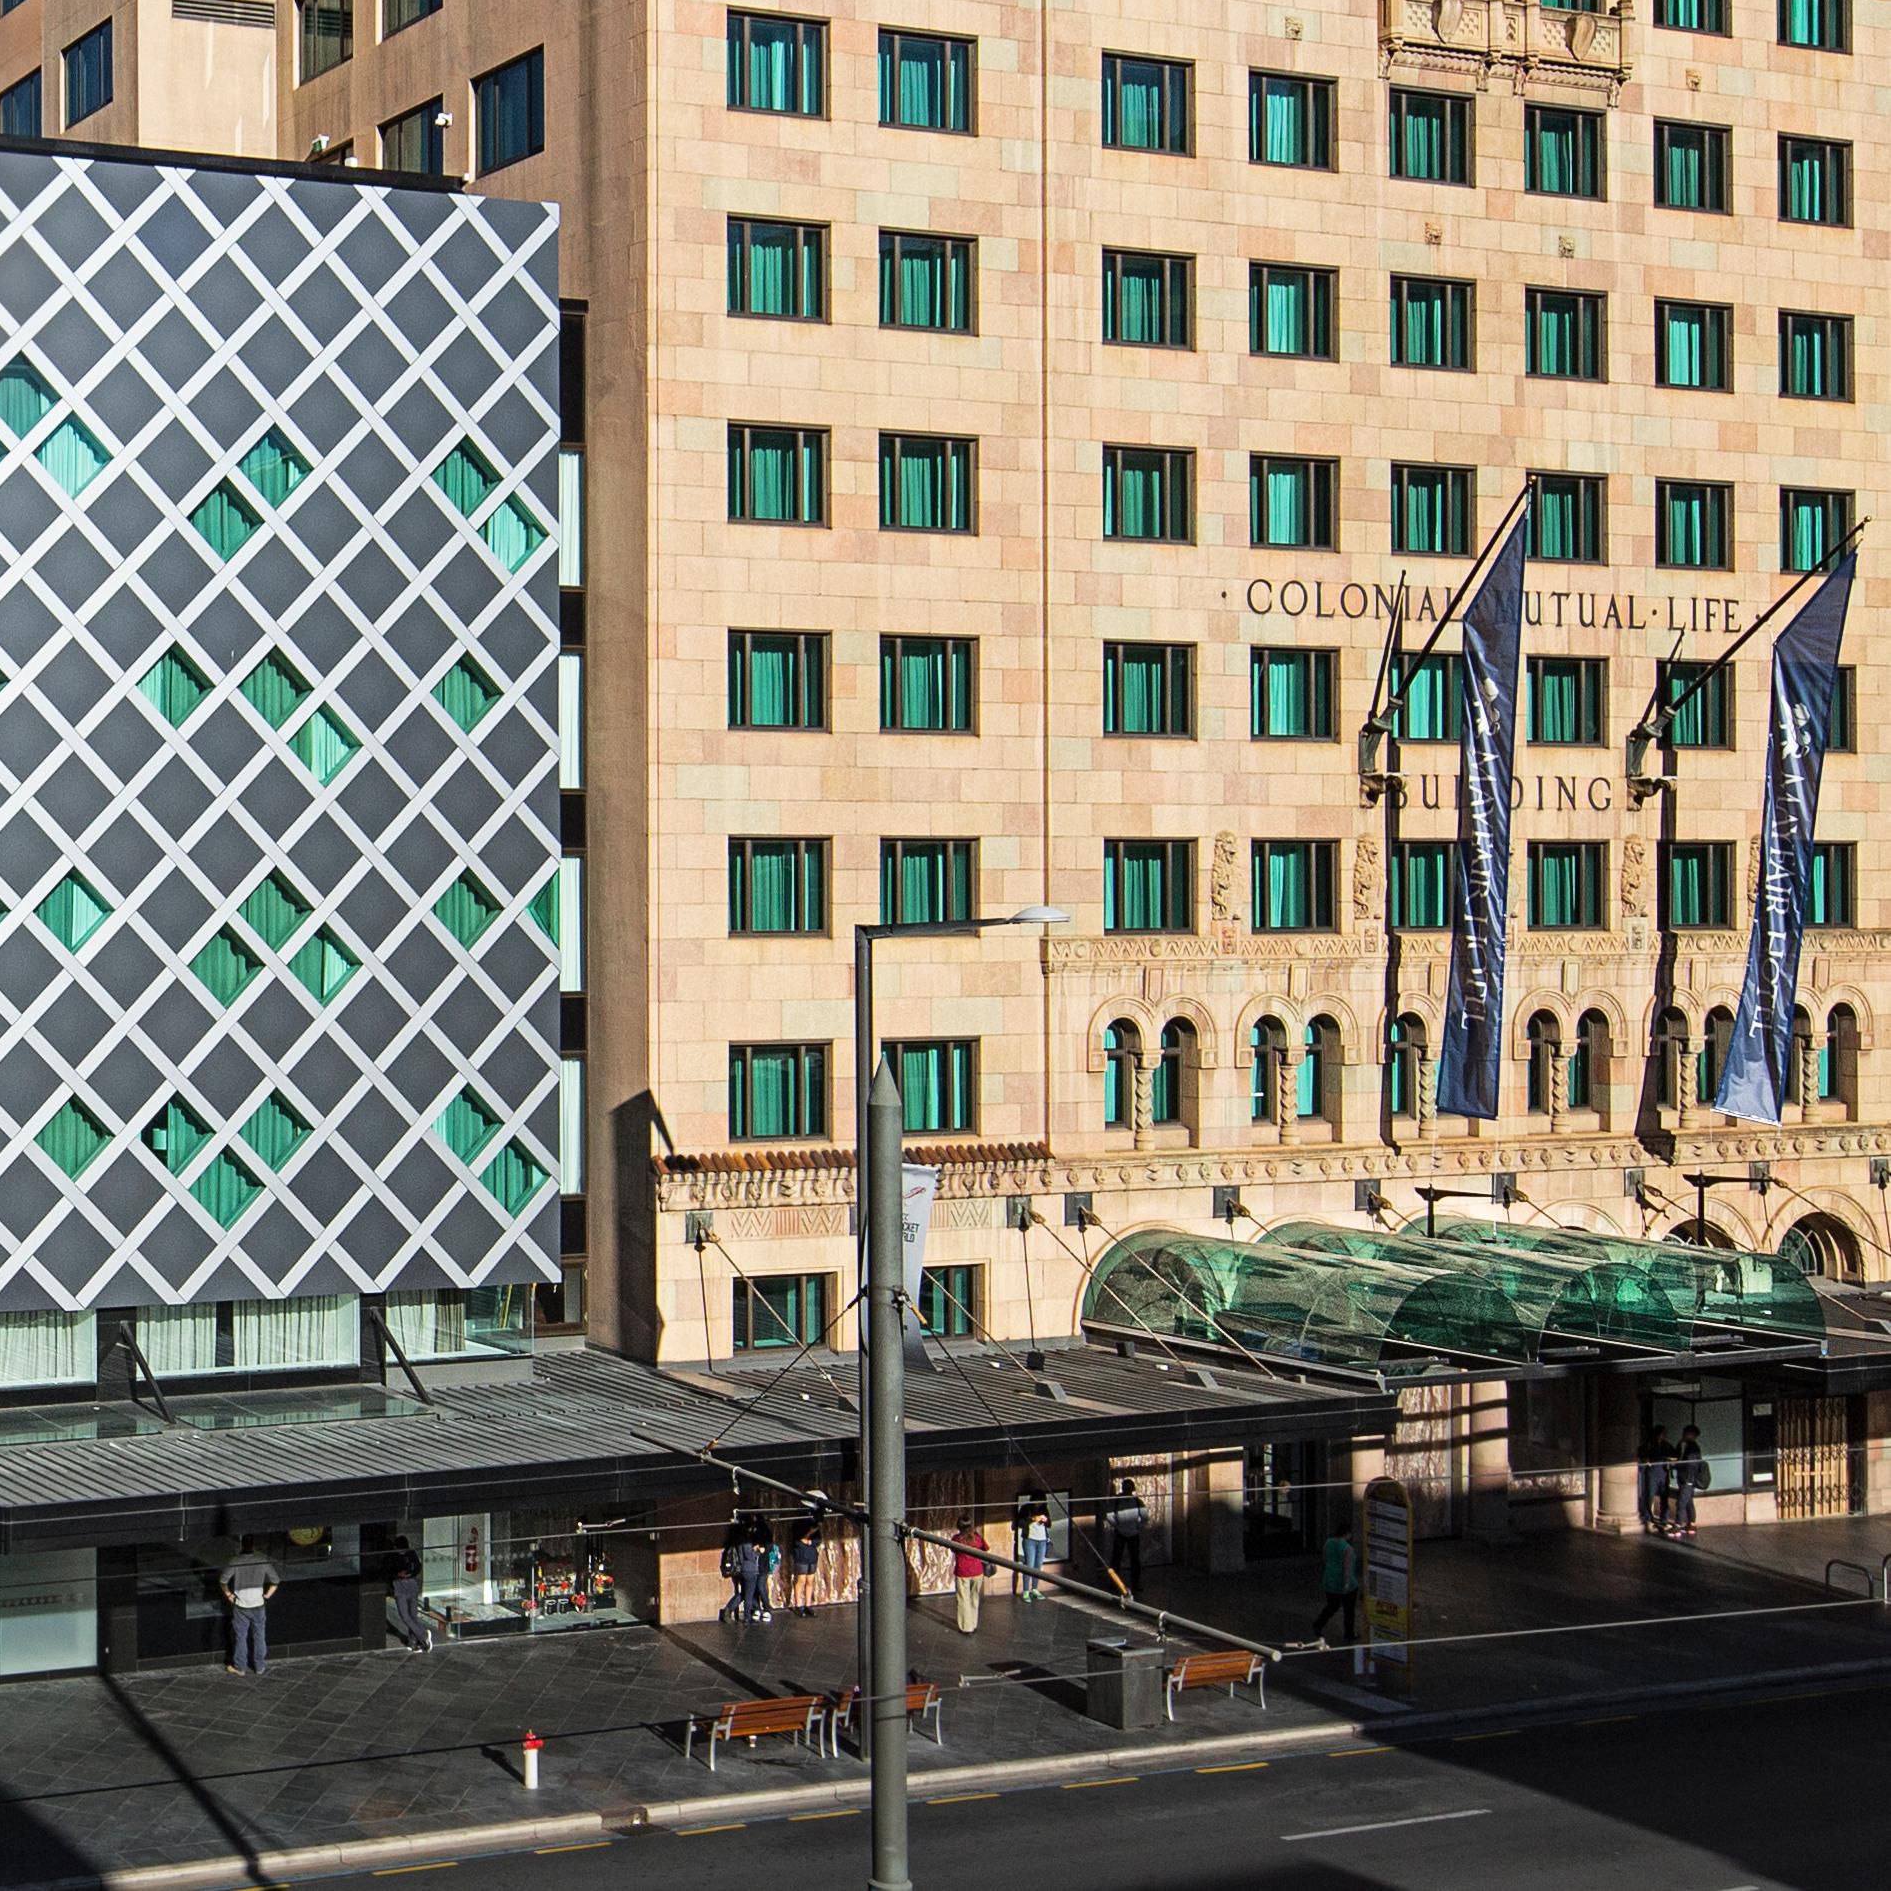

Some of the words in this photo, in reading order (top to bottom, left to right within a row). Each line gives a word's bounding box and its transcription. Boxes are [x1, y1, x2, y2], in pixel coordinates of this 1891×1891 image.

[1246, 578, 1464, 622] COLONIAL
[1523, 590, 1647, 630] UTUAL
[1667, 596, 1742, 634] LIFE
[1764, 770, 1807, 914] MAYFAIR
[1748, 928, 1786, 1040] HOTEL
